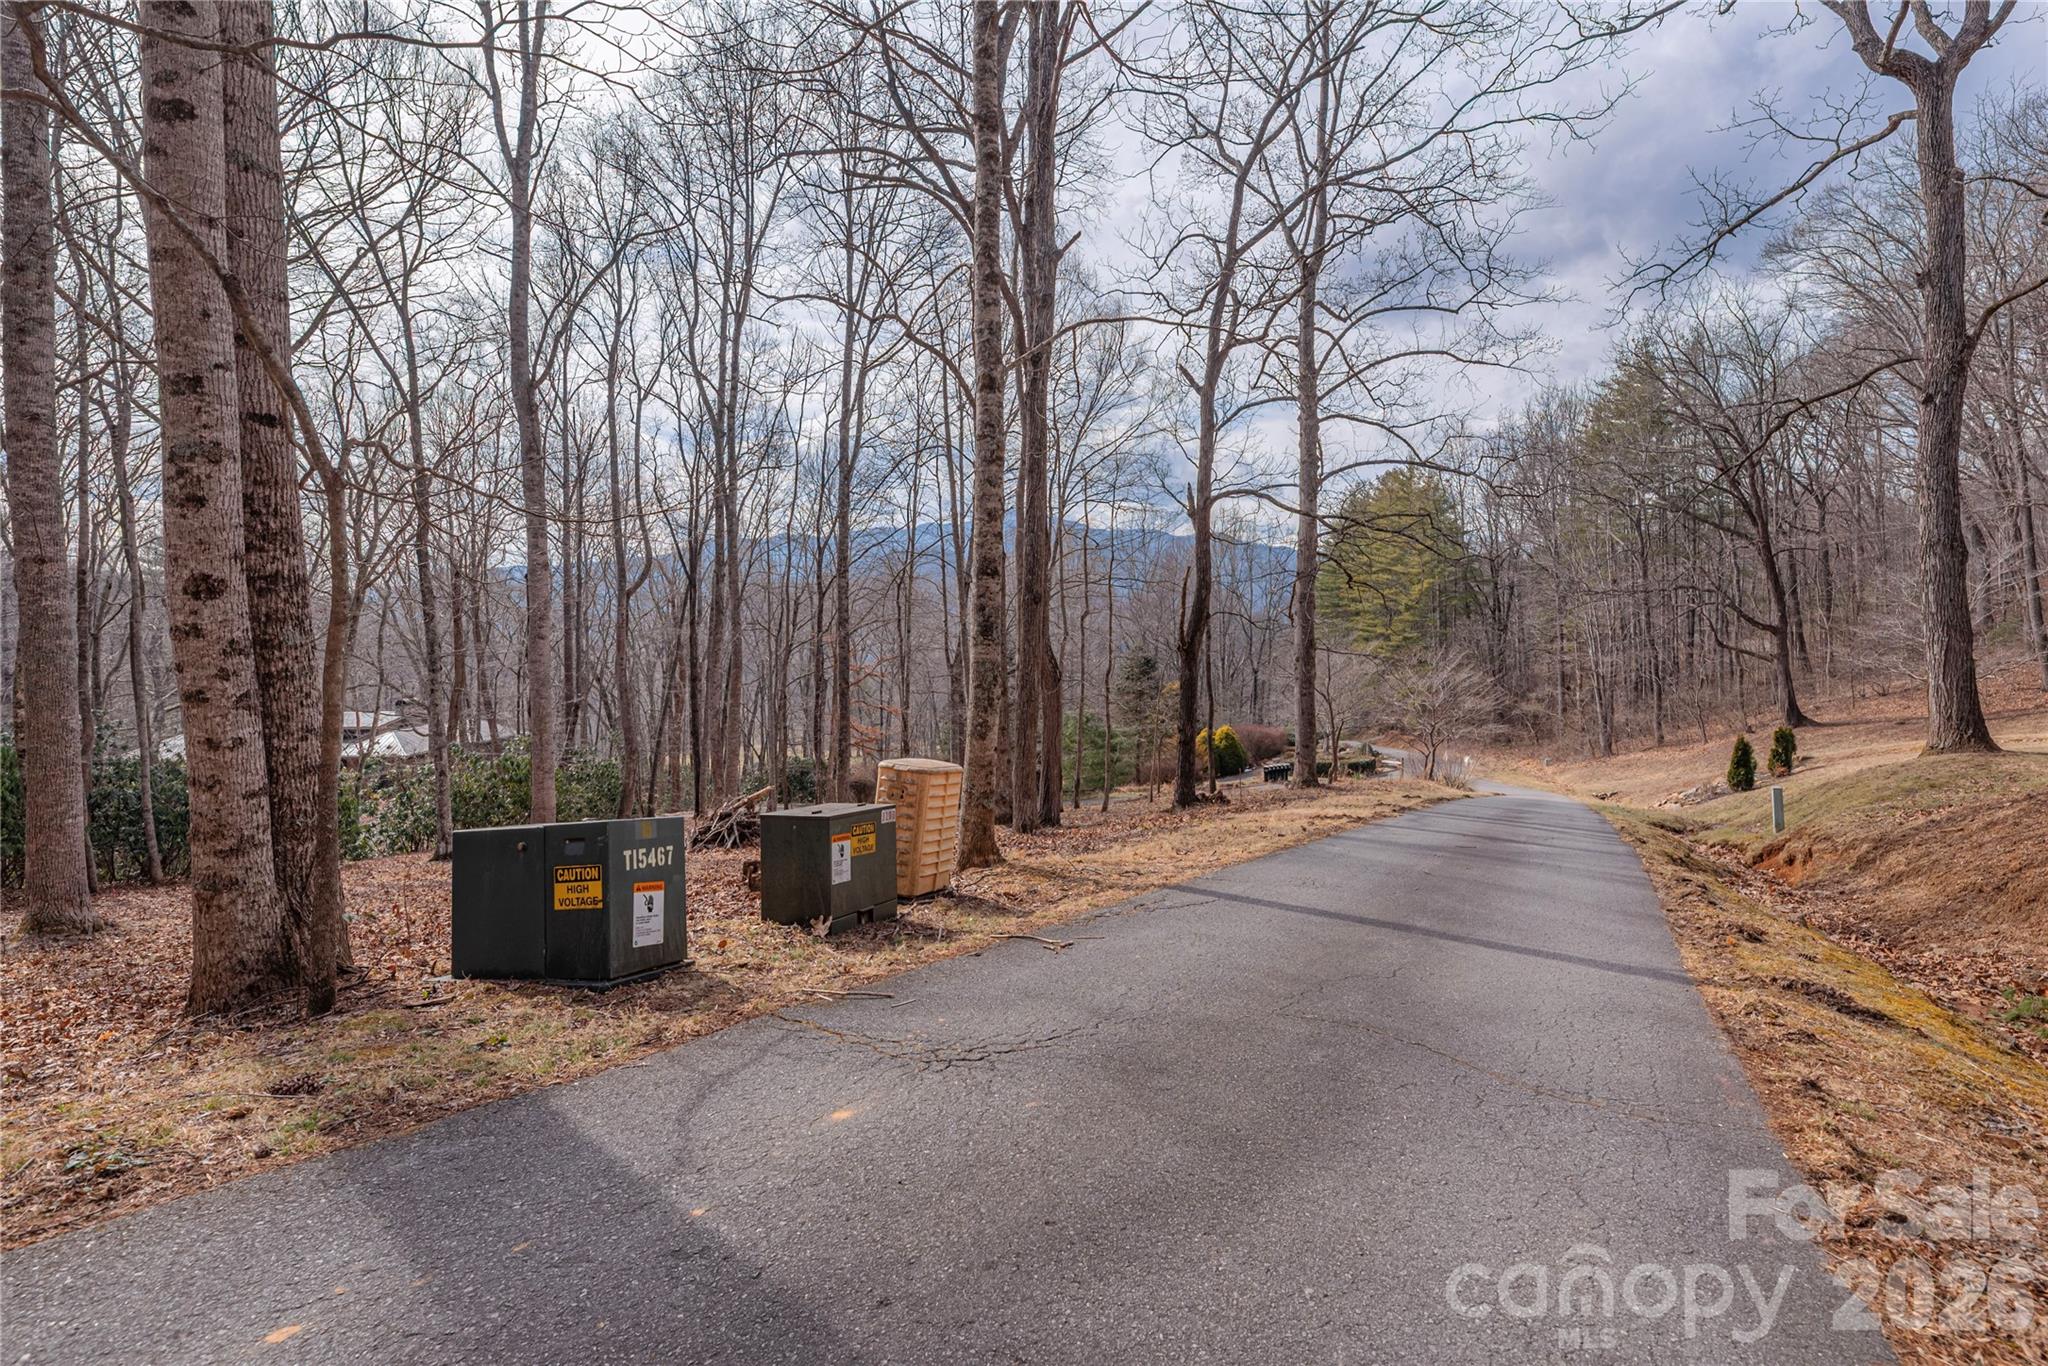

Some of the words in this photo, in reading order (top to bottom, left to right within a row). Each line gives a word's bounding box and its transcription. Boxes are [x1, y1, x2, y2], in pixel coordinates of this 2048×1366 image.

[556, 866, 599, 882] CAUTION
[566, 884, 589, 894] HIGH
[558, 896, 599, 907] VOLTAGE
